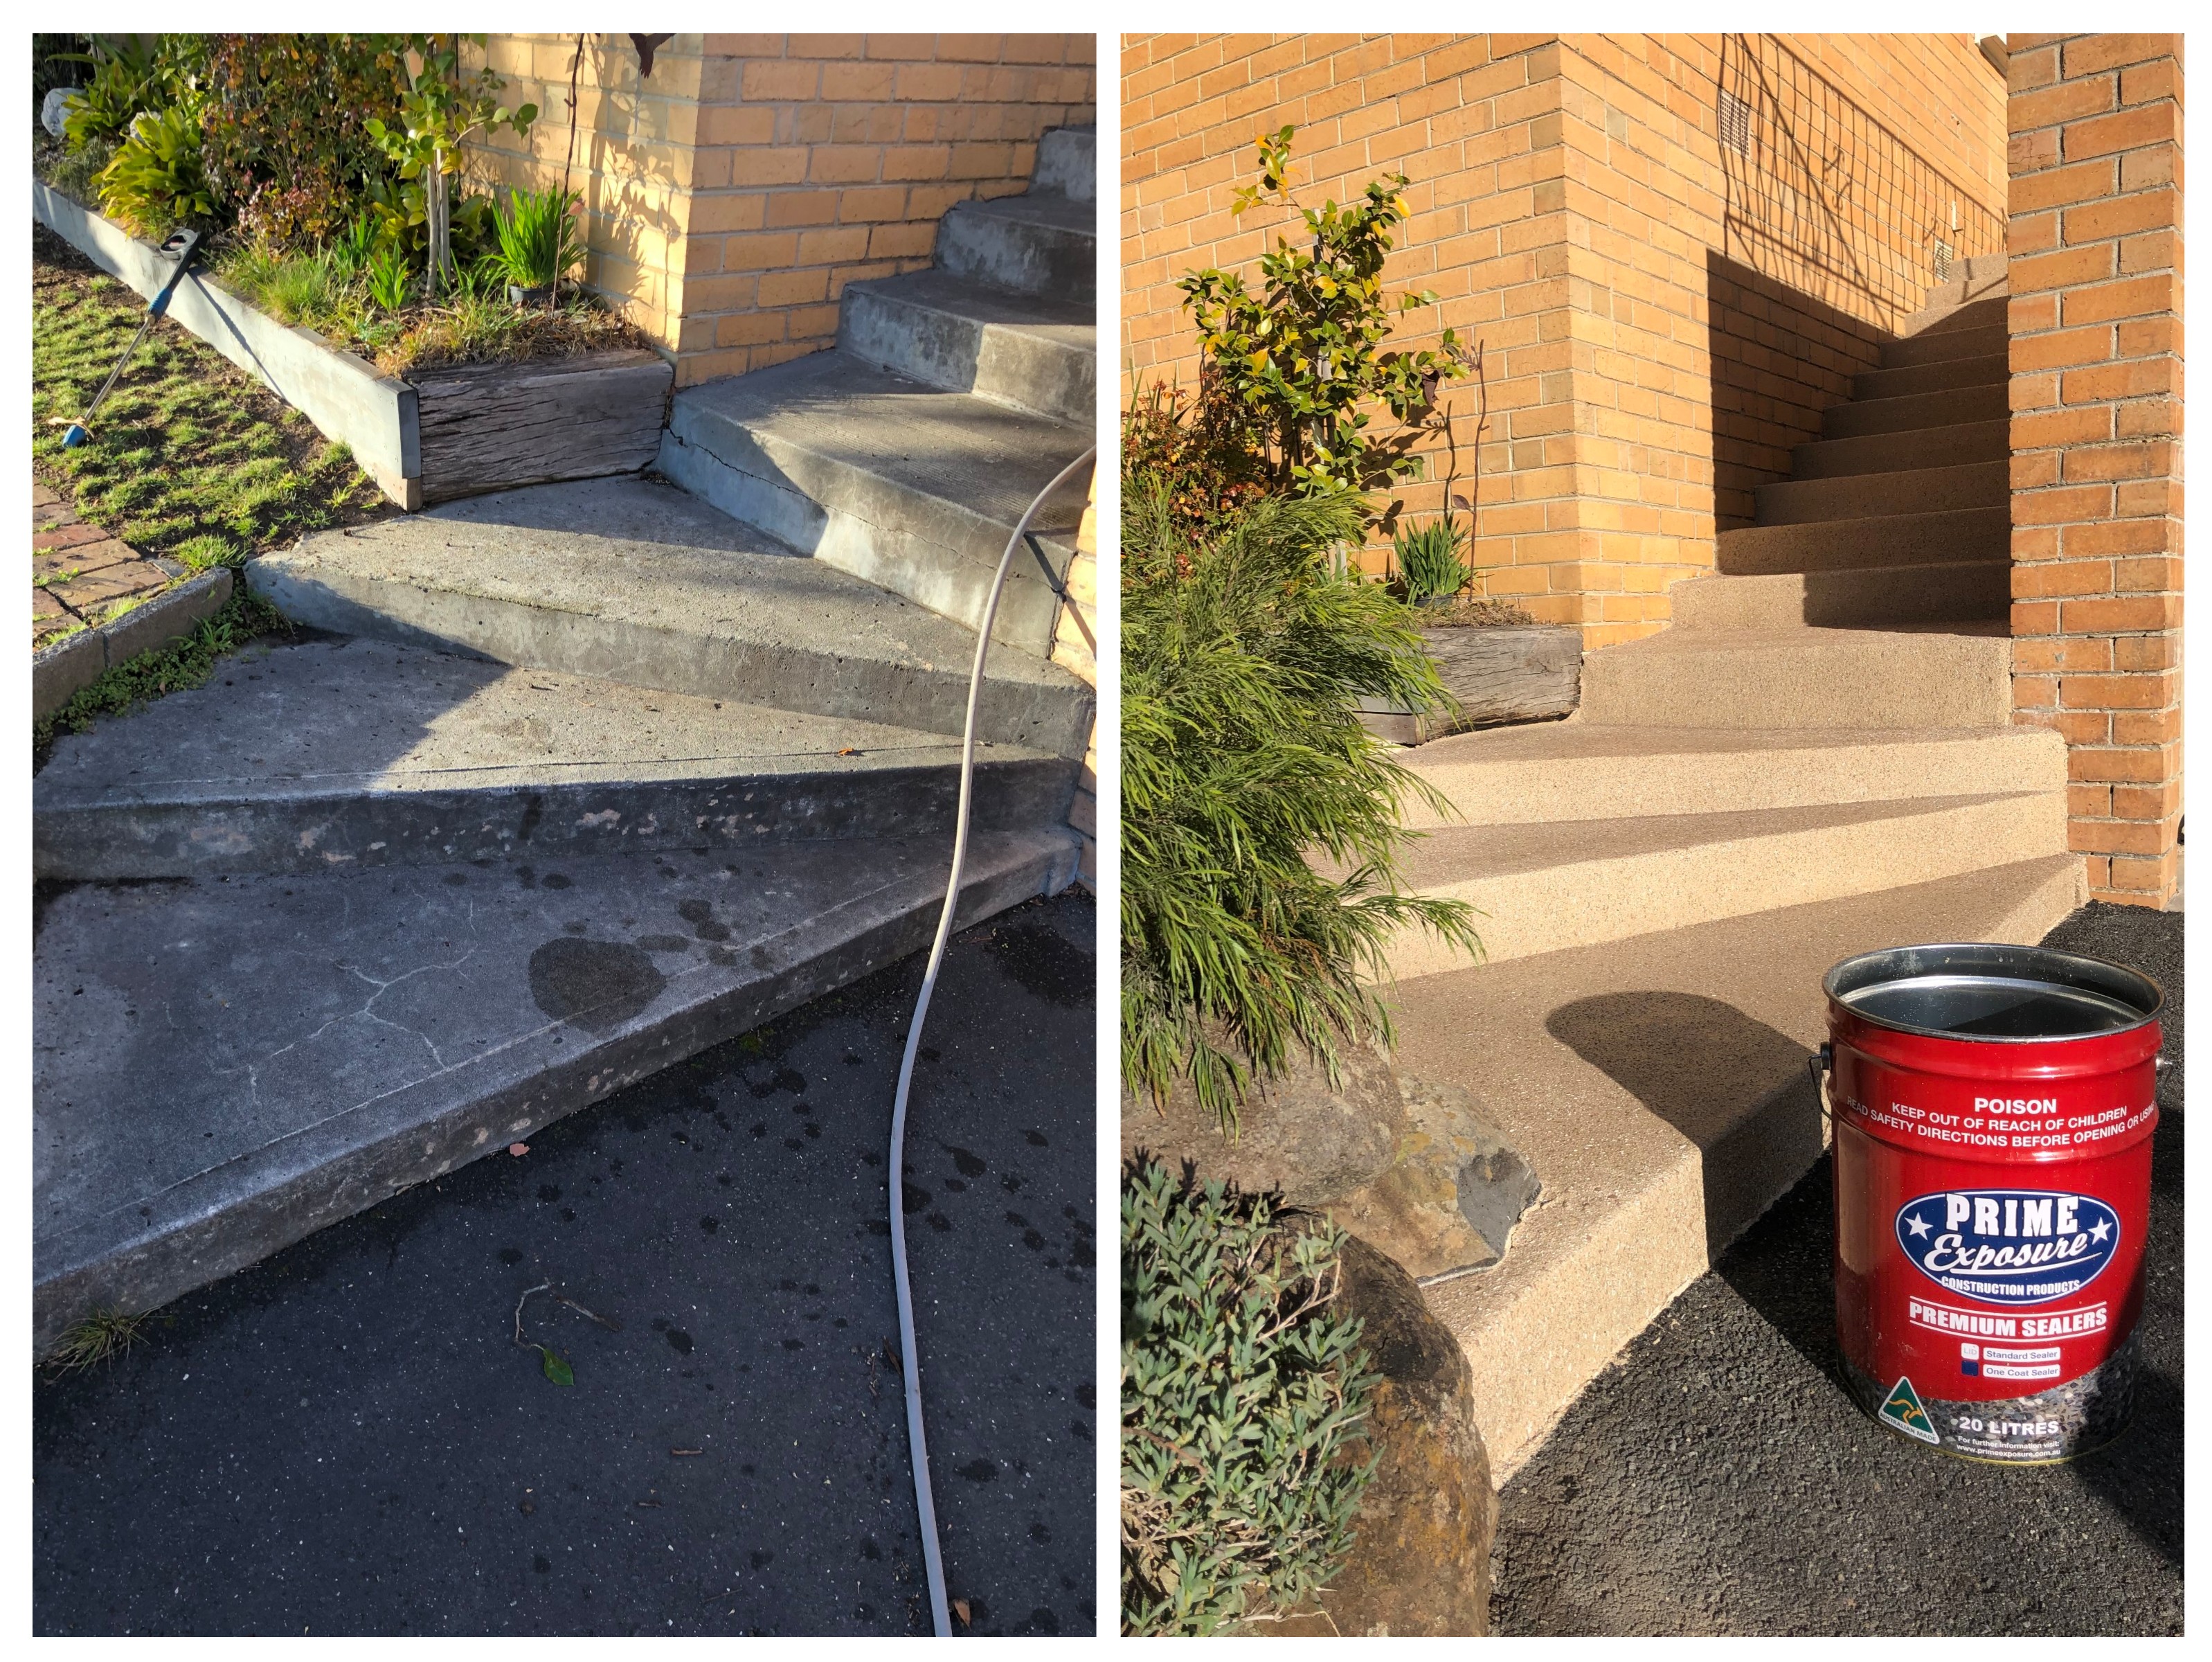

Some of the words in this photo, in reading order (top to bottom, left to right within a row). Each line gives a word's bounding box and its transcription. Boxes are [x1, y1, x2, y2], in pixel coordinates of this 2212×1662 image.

[1975, 1098, 2057, 1114] POISON
[1846, 1096, 1869, 1116] READ
[1870, 1109, 1914, 1133] SAFETY
[1917, 1125, 2008, 1147] DIRECTIONS
[2012, 1134, 2070, 1147] BEFORE
[2074, 1124, 2125, 1143] OPENING
[2127, 1117, 2139, 1129] OR
[1891, 1102, 1926, 1120] KEEP
[1929, 1112, 1960, 1126] OUT
[1963, 1118, 1984, 1129] OF
[1988, 1120, 2041, 1132] REACH
[2045, 1118, 2065, 1130] OF
[2068, 1106, 2128, 1129] CHILDREN
[1946, 1193, 2079, 1237] PRIME
[1924, 1233, 2087, 1271] Exposure
[1941, 1276, 2024, 1296] CONSTRUCTION
[2026, 1280, 2080, 1296] PRODUCTS
[1909, 1301, 2015, 1337] PREMIUM
[2022, 1308, 2107, 1337] SEALERS
[1963, 1346, 1977, 1355] LID
[1986, 1350, 2028, 1359] Standard
[2030, 1351, 2058, 1359] Sealer
[1986, 1367, 2005, 1376] One
[2031, 1368, 2058, 1377] Sealer
[1880, 1413, 1915, 1434] AUSTRALIAN
[1916, 1431, 1936, 1441] MADE
[1959, 1416, 1983, 1432] 20
[1989, 1420, 2059, 1436] LITRES
[1956, 1444, 2061, 1458] www.primeexposure.com.au
[1958, 1436, 1971, 1444] For
[1972, 1438, 1998, 1447] further
